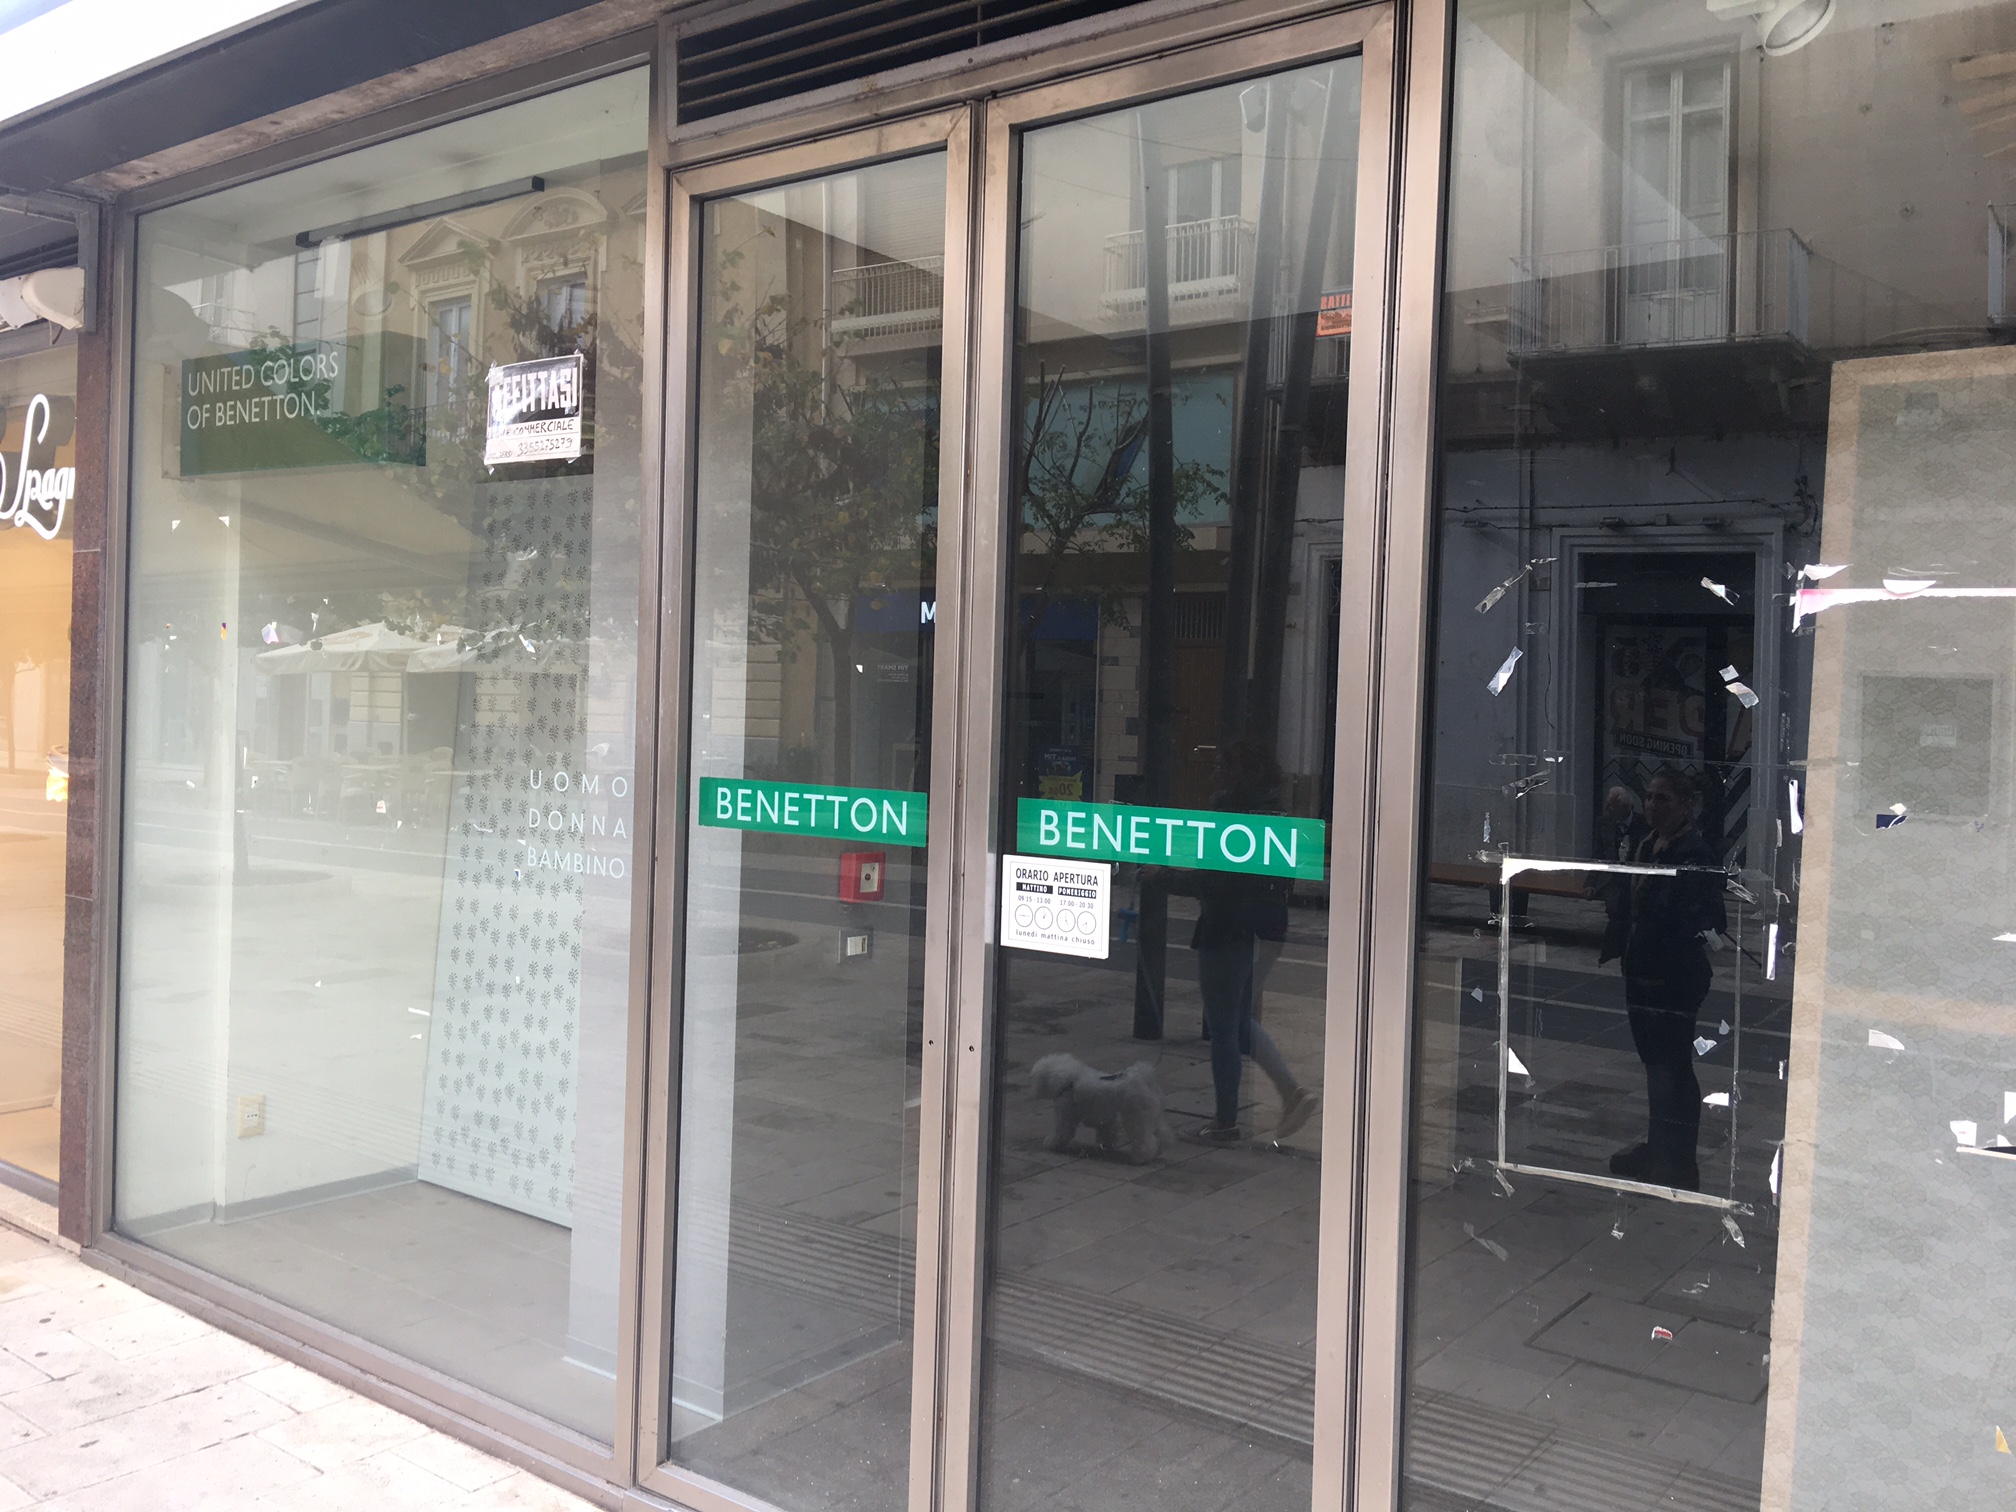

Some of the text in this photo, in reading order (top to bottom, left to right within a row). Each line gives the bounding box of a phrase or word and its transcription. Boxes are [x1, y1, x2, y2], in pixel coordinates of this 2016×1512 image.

[188, 352, 339, 396] UNITED COLORS
[187, 404, 211, 430] OF
[513, 419, 574, 436] COMMERCIALE
[530, 769, 628, 798] UOMO
[528, 808, 627, 839] DONNA
[716, 787, 908, 836] BENETTON
[1039, 809, 1298, 868] BENETTON
[527, 845, 625, 879] BAMBINO
[1015, 867, 1098, 887] ORARIO APERTURA
[1021, 883, 1048, 893] MATTINO
[1058, 886, 1097, 898] POMERIGGIO
[1040, 932, 1068, 942] mattina
[1071, 935, 1096, 945] chiuso
